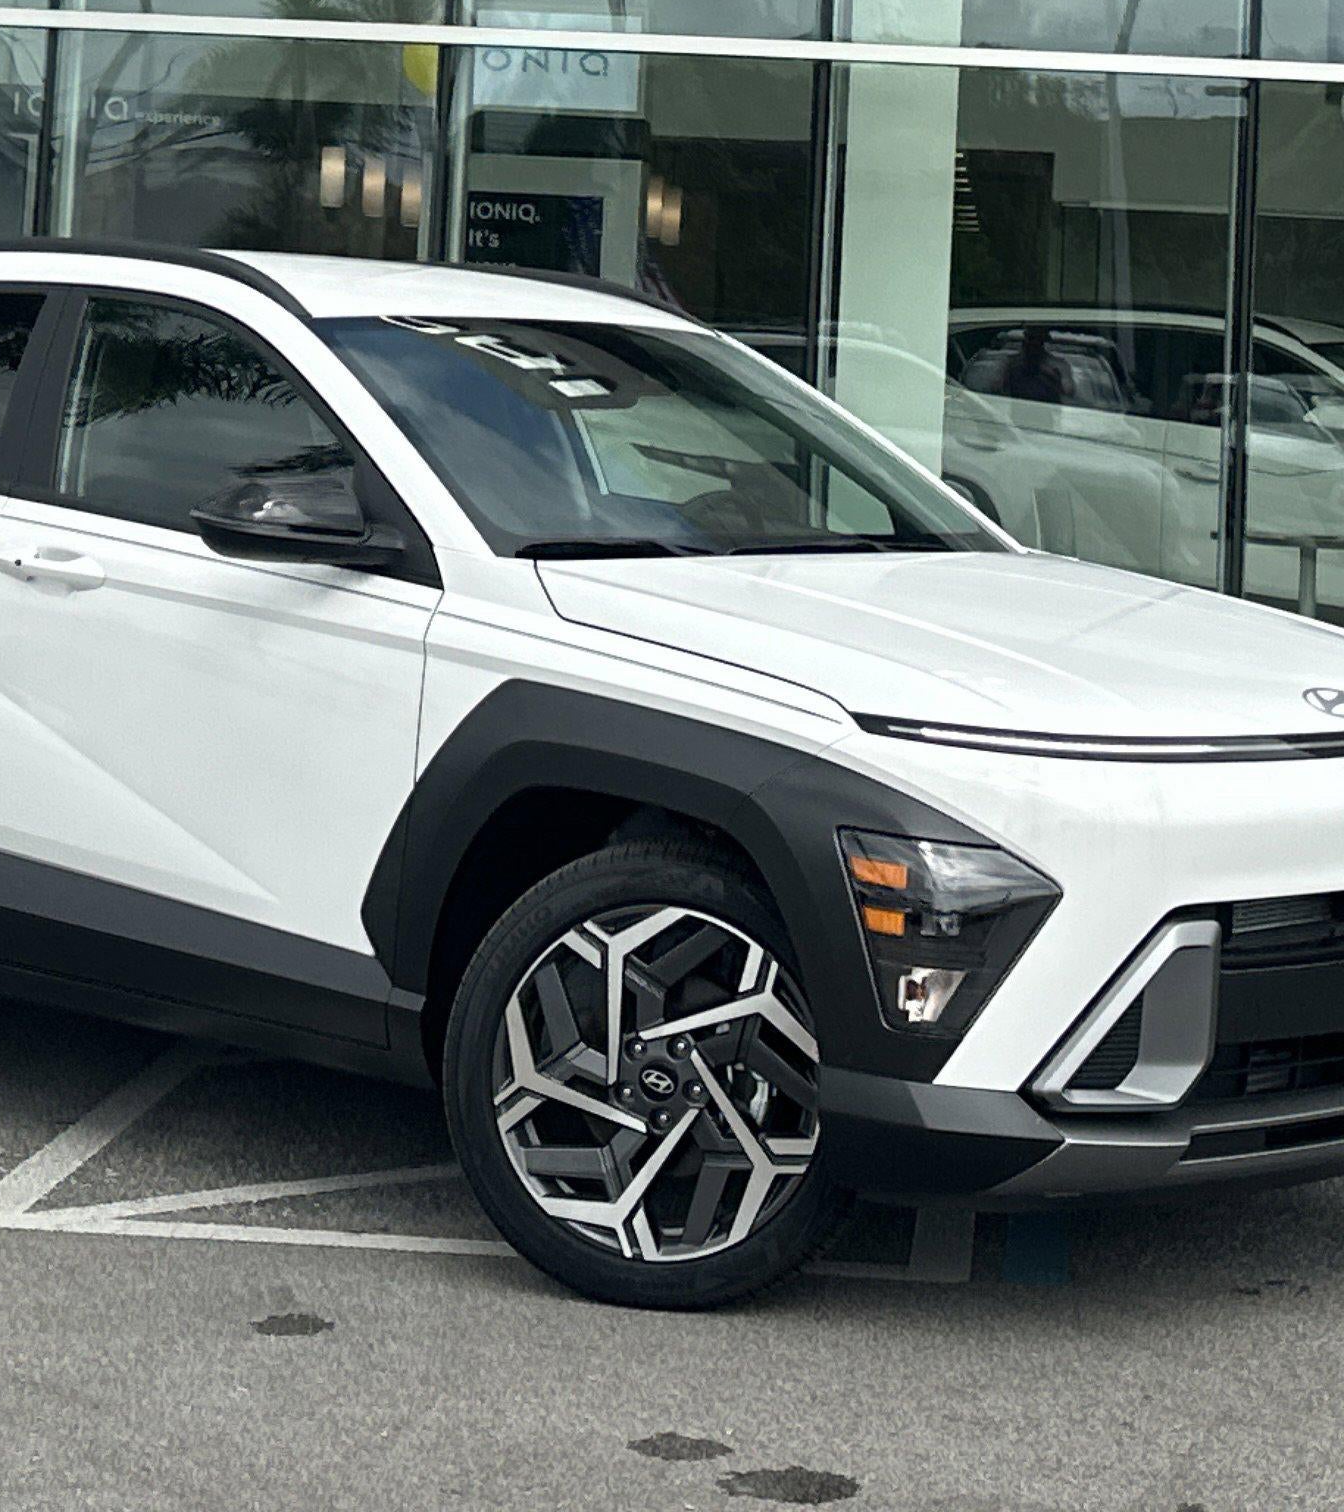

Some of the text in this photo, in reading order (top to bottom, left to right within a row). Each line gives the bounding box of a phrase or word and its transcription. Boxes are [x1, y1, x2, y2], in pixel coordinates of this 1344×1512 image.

[482, 48, 609, 77] ONIQ
[469, 200, 541, 224] IONIQ.
[468, 228, 500, 248] It's
